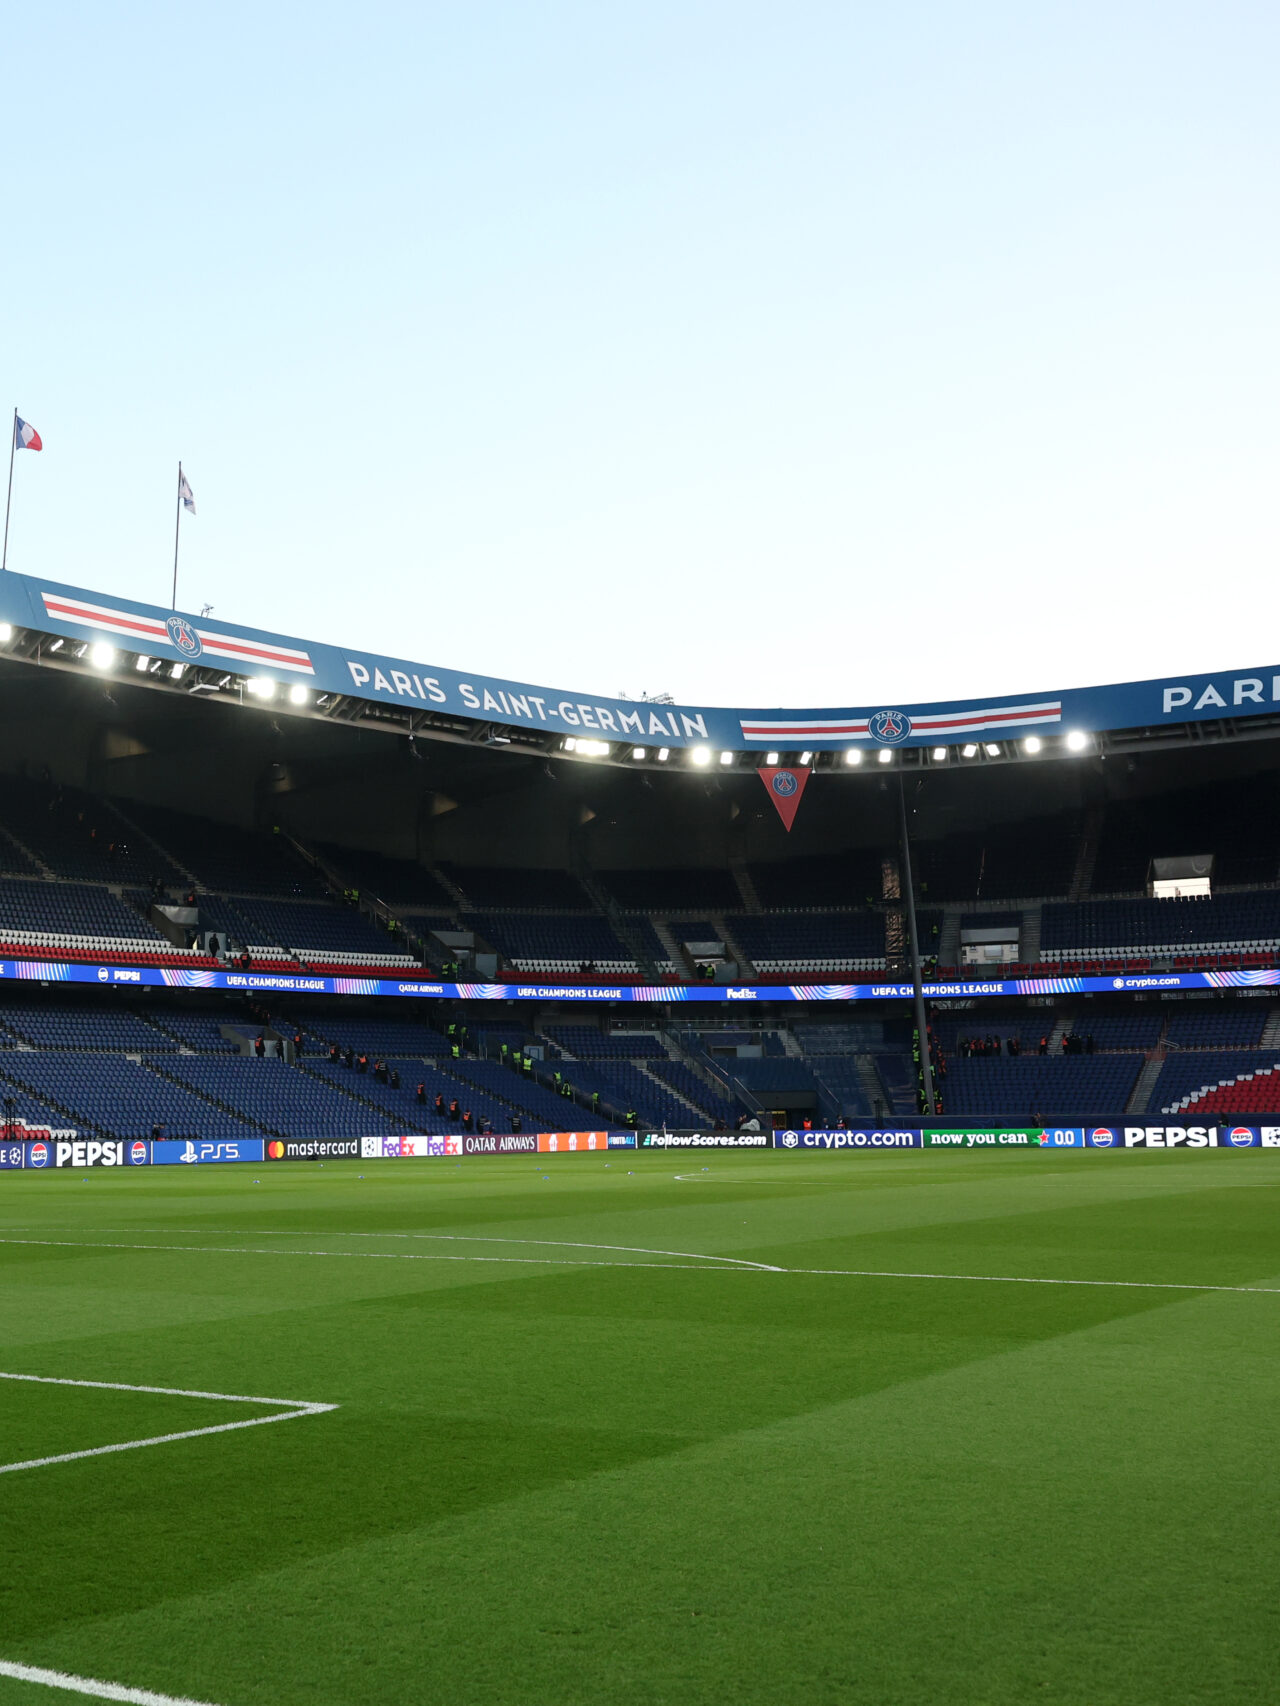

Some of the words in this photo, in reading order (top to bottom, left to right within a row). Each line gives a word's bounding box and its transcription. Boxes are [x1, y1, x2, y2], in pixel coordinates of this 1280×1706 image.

[346, 661, 446, 703] PARIS
[458, 683, 710, 739] SAINT-GERMAIN
[114, 970, 140, 981] PEPSI
[227, 976, 247, 986] UEFA
[248, 977, 295, 989] CHAMPIONS
[295, 979, 325, 990] LEAGUE
[1126, 977, 1180, 987] crypto.com
[398, 984, 419, 993] QATAR
[517, 988, 537, 996] UEFA
[538, 989, 586, 998] CHAMPIONS
[587, 990, 621, 998] LEAGUE
[872, 987, 897, 996] UEFA
[900, 985, 960, 996] CHMPIONS
[963, 984, 1003, 993] LEAGUE
[466, 1137, 496, 1152] QATAR
[499, 1136, 535, 1150] AIRWAYS
[804, 1129, 913, 1147] crypto.com
[930, 1133, 964, 1144] now
[966, 1134, 997, 1146] you
[999, 1133, 1028, 1144] can
[1054, 1131, 1074, 1145] 0.0
[1124, 1127, 1218, 1147] PEPSI
[201, 1144, 239, 1159] PS5
[287, 1139, 358, 1156] mastercard
[382, 1137, 415, 1157] FedEx
[427, 1136, 458, 1156] FedEx
[56, 1141, 123, 1167] PEPSI
